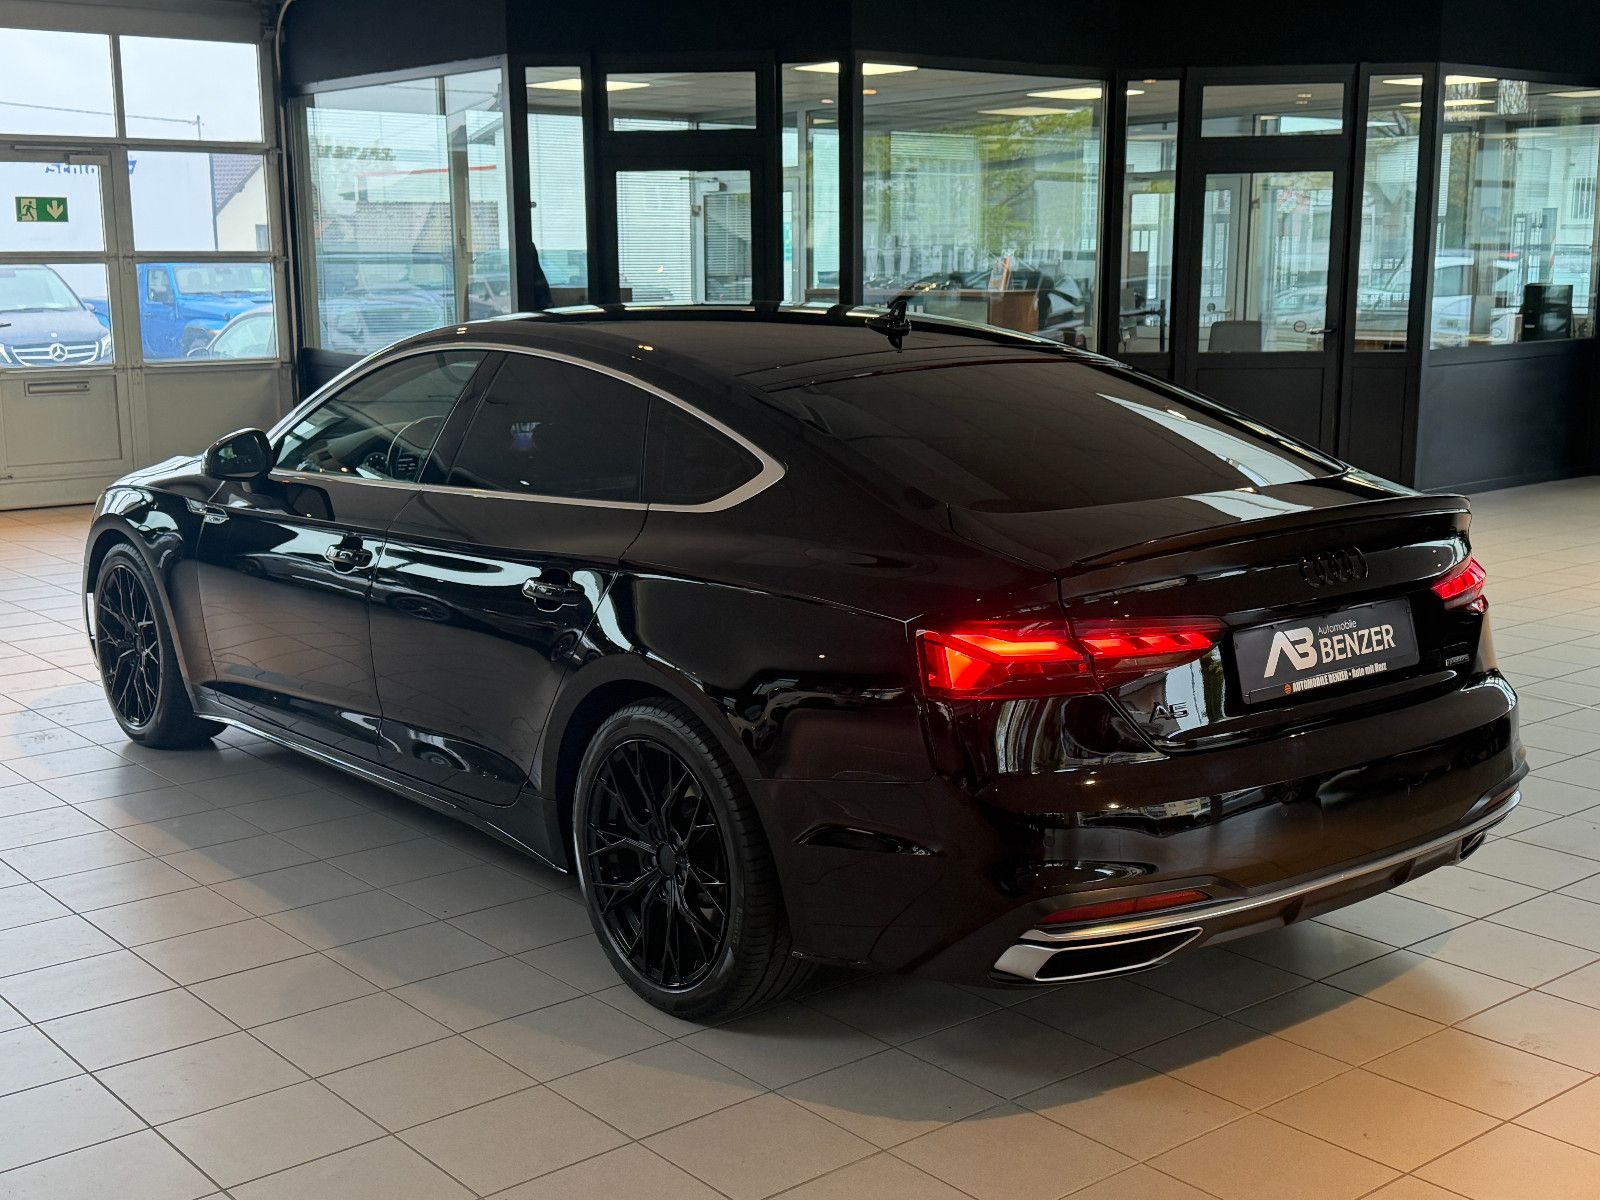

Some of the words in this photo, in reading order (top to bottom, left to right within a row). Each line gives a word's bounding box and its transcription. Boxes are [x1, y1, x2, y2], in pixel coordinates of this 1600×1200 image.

[1317, 619, 1357, 636] Automobile
[1318, 624, 1397, 664] BENZER
[1292, 674, 1329, 692] AUTOMOBILE
[1328, 670, 1349, 684] BENZER
[1148, 701, 1189, 723] A5
